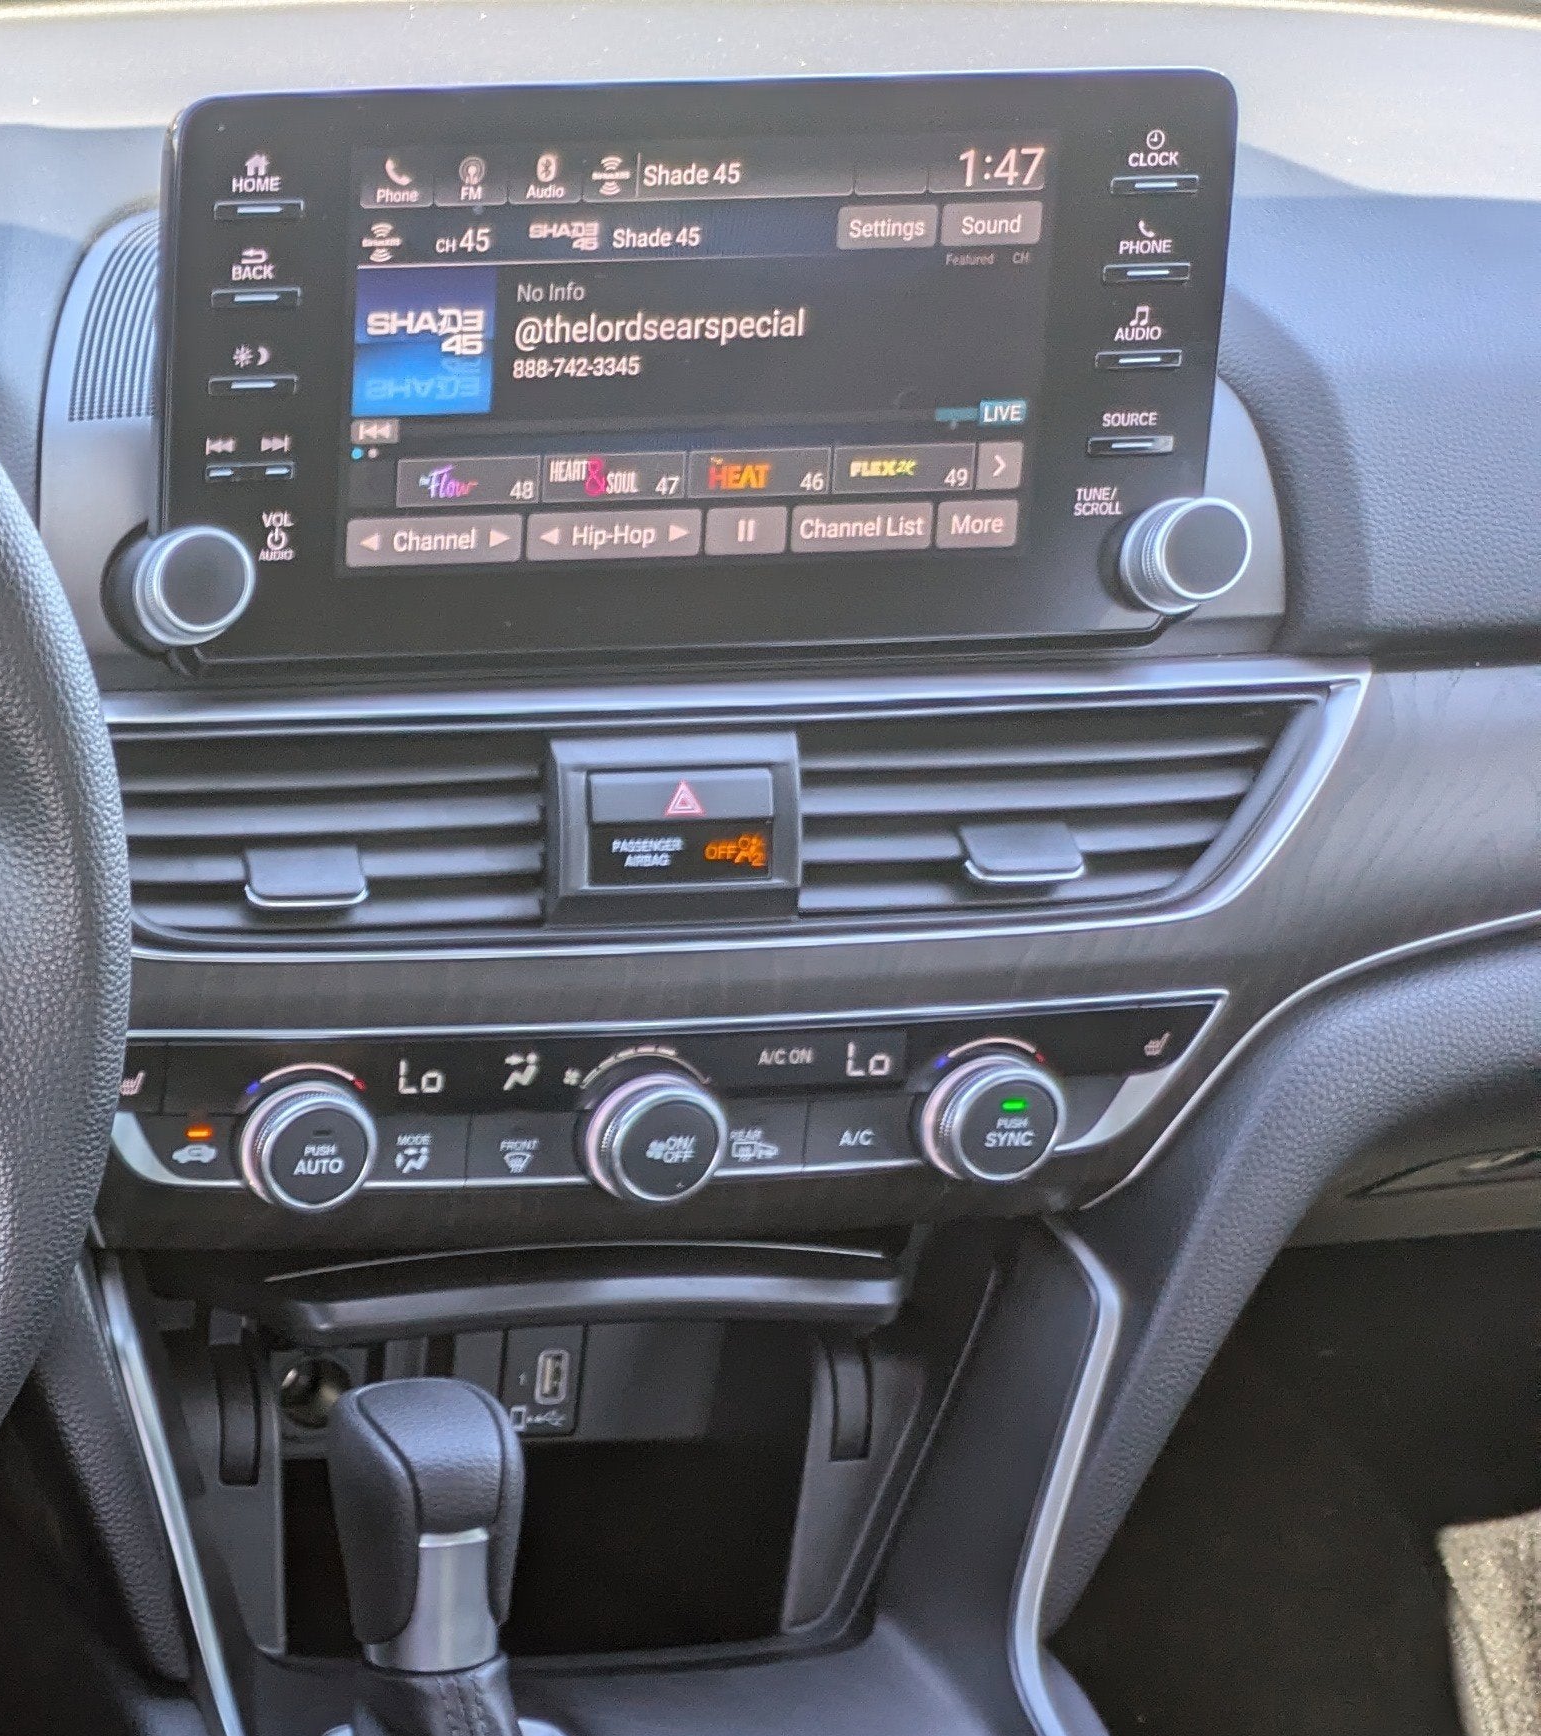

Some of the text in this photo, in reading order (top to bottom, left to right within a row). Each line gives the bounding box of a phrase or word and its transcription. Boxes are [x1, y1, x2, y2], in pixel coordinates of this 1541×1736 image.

[958, 146, 1044, 186] 1:47
[1128, 152, 1177, 166] CLOCK
[643, 164, 707, 186] Shade
[713, 161, 740, 182] 45
[232, 176, 279, 192] HOME
[526, 184, 564, 198] Audio
[376, 188, 417, 202] Phone
[460, 186, 481, 199] FM
[849, 218, 923, 240] Settings
[961, 214, 1020, 234] Sound
[435, 228, 490, 251] CH 45
[612, 227, 700, 248] Shade 45
[1119, 240, 1171, 254] PHONE
[232, 264, 274, 279] BACK
[517, 282, 584, 301] No Info
[367, 309, 484, 334] SHADE
[516, 309, 806, 351] @thelordsearspecial
[1114, 326, 1161, 340] AUDIO
[441, 334, 483, 354] 45
[513, 355, 641, 377] 888-742-3345
[983, 404, 1022, 421] LIVE
[1102, 412, 1157, 426] SOURCE
[549, 460, 585, 482] HEART
[605, 471, 638, 493] SOUL
[655, 475, 679, 493] 47
[708, 463, 823, 489] HEAT 46
[943, 467, 967, 486] 49
[510, 480, 533, 498] 48
[1076, 487, 1114, 499] TUNE/
[1074, 500, 1120, 514] SCROLL
[262, 512, 290, 524] VOL
[799, 513, 922, 537] Channel List
[950, 514, 1002, 533] More
[392, 528, 476, 550] Channel
[571, 523, 654, 548] Hip-Hop
[258, 548, 292, 559] AUDIO
[611, 838, 682, 852] PASSENGER
[704, 845, 735, 859] OFF
[623, 854, 669, 866] AIRBAG
[758, 1049, 811, 1065] A/C ON
[996, 1118, 1027, 1128] PUSH
[397, 1134, 429, 1144] MODE
[730, 1130, 761, 1141] REAR
[839, 1131, 872, 1146] A/C
[984, 1131, 1033, 1147] SYNC
[303, 1145, 335, 1156] PUSH
[499, 1138, 538, 1150] FRONT
[293, 1159, 343, 1175] AUTO
